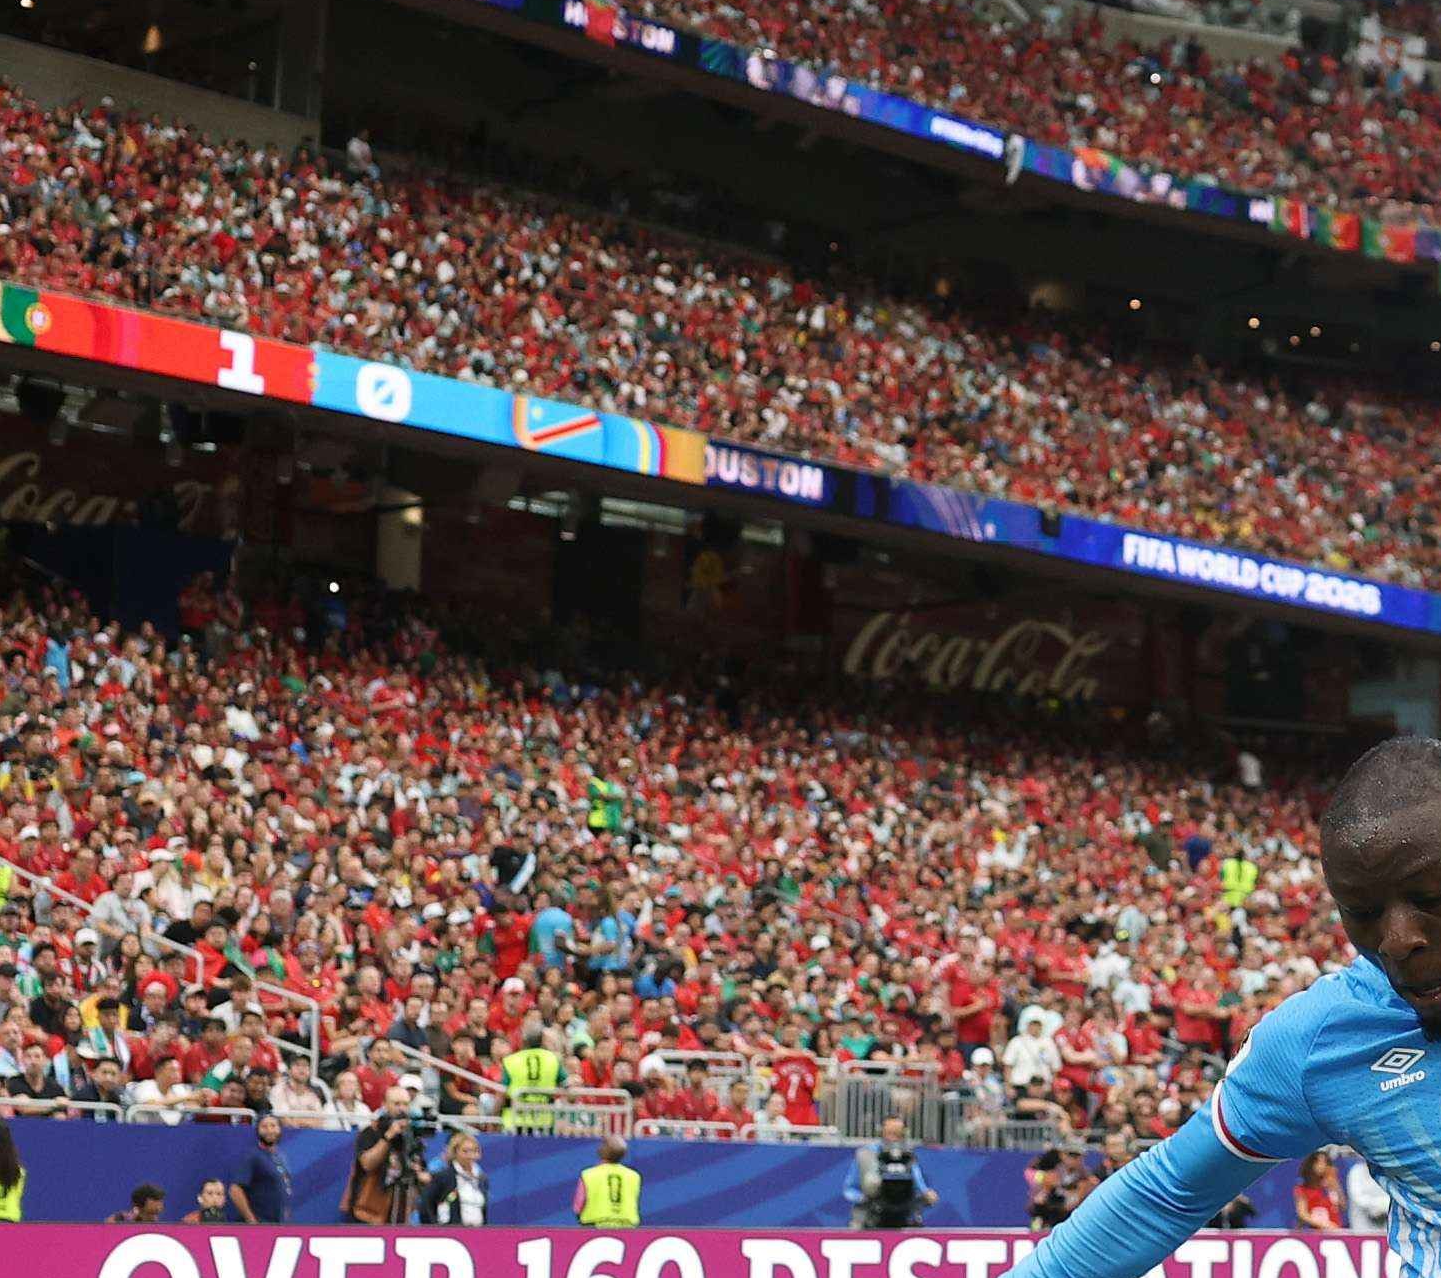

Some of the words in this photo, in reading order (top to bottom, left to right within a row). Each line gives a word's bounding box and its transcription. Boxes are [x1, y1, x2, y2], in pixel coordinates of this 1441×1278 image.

[218, 329, 265, 396] 1
[356, 361, 412, 423] 0
[1123, 532, 1176, 573] FIFA
[1175, 544, 1259, 590] WORLD
[1259, 562, 1306, 599] CUP
[1304, 572, 1382, 615] 2026
[1379, 1068, 1426, 1093] umbro
